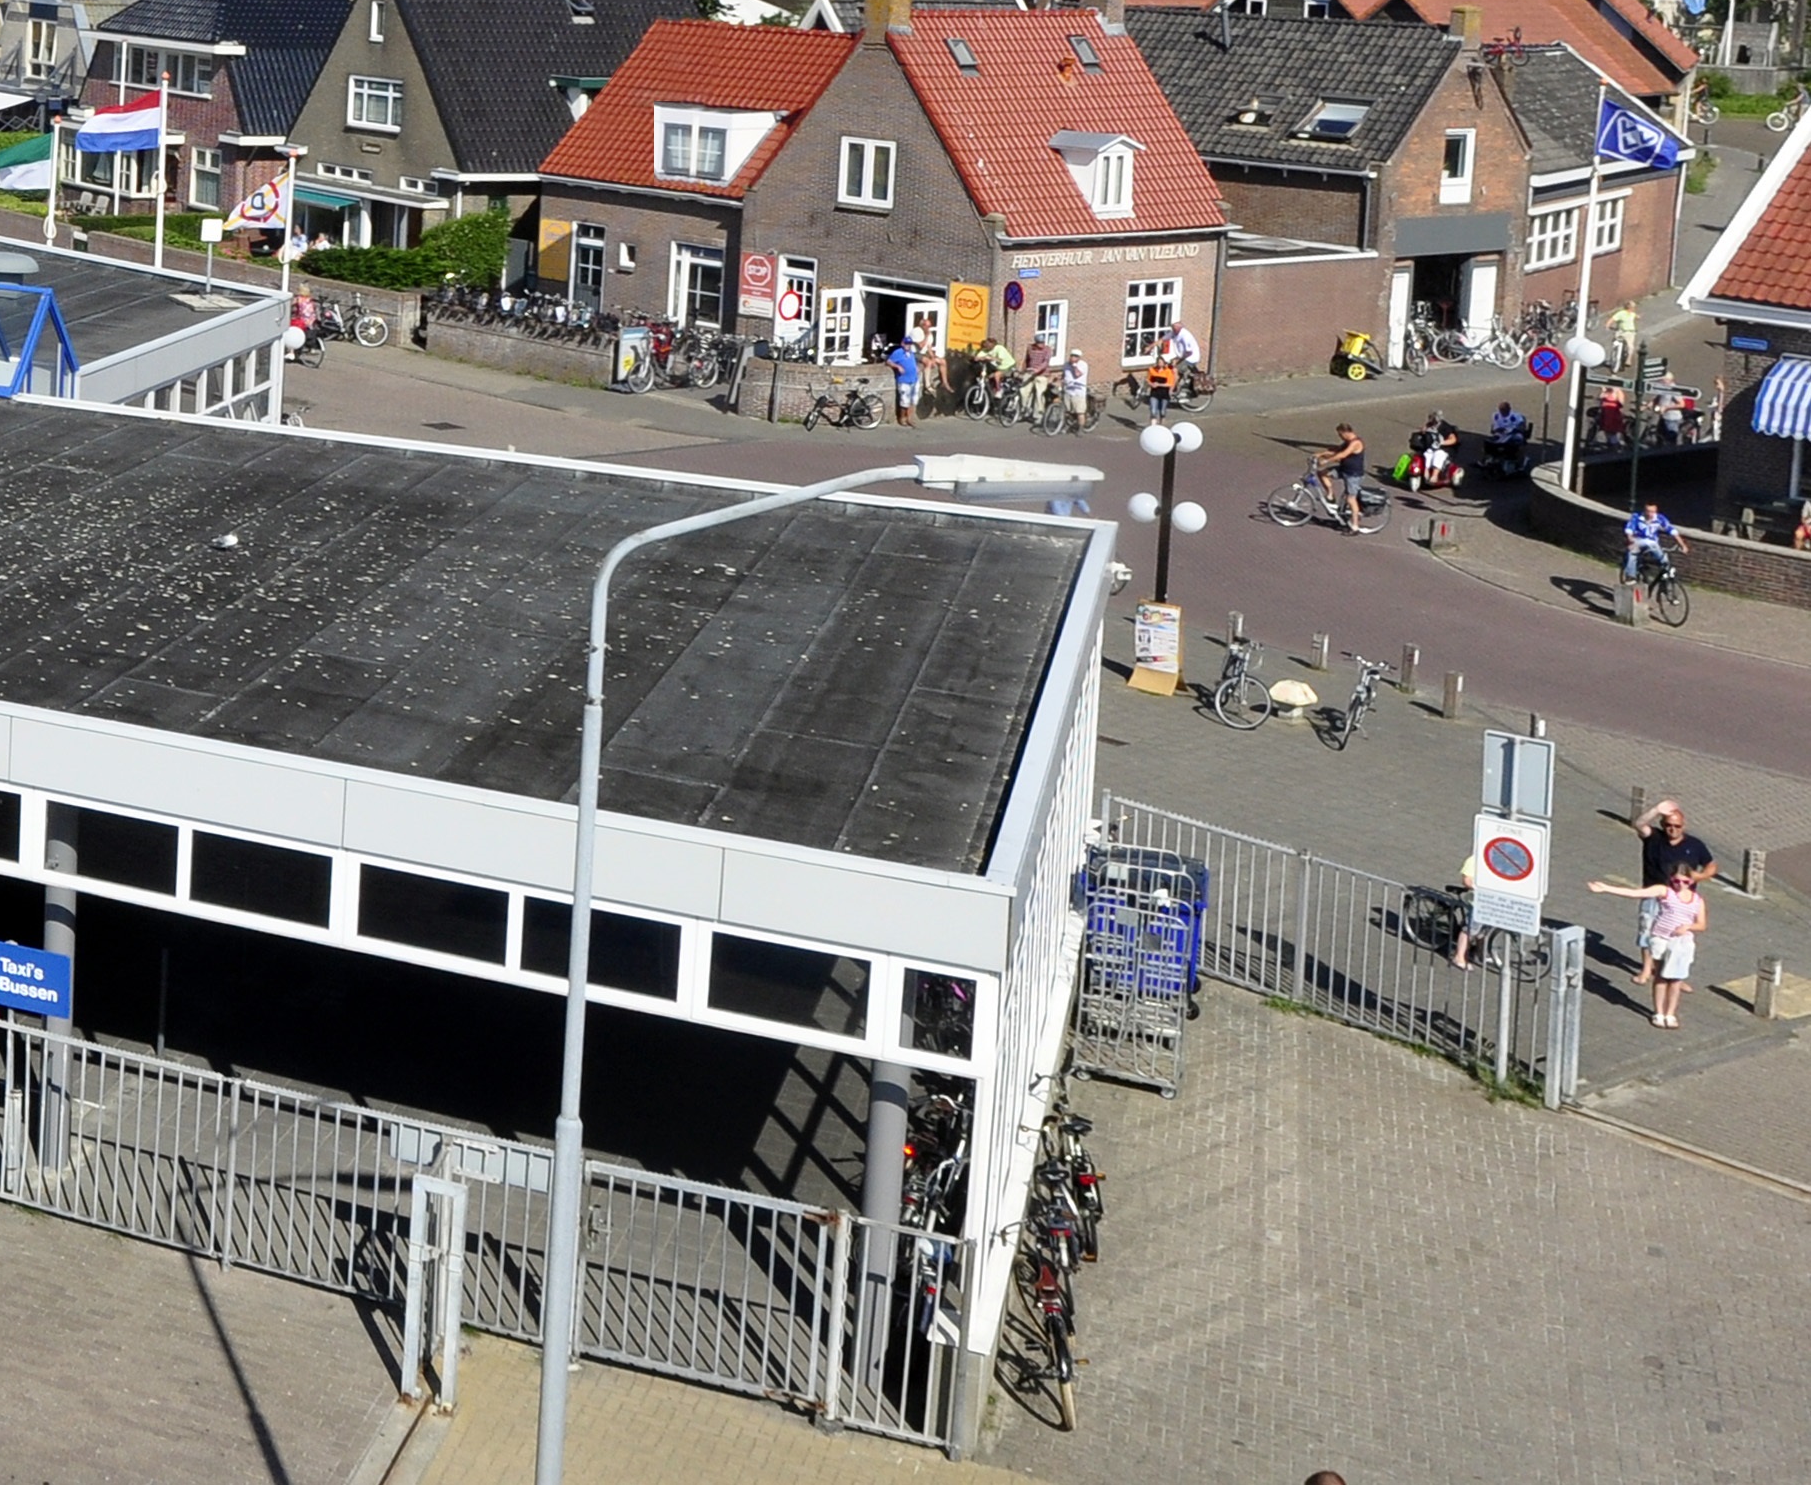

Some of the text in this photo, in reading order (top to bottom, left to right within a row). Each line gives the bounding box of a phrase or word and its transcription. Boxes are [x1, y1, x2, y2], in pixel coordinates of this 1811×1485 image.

[1011, 244, 1200, 268] FIETSVERHUUR JAN VAN VLIELAND
[957, 298, 979, 309] STOP
[0, 956, 44, 981] Taxi's
